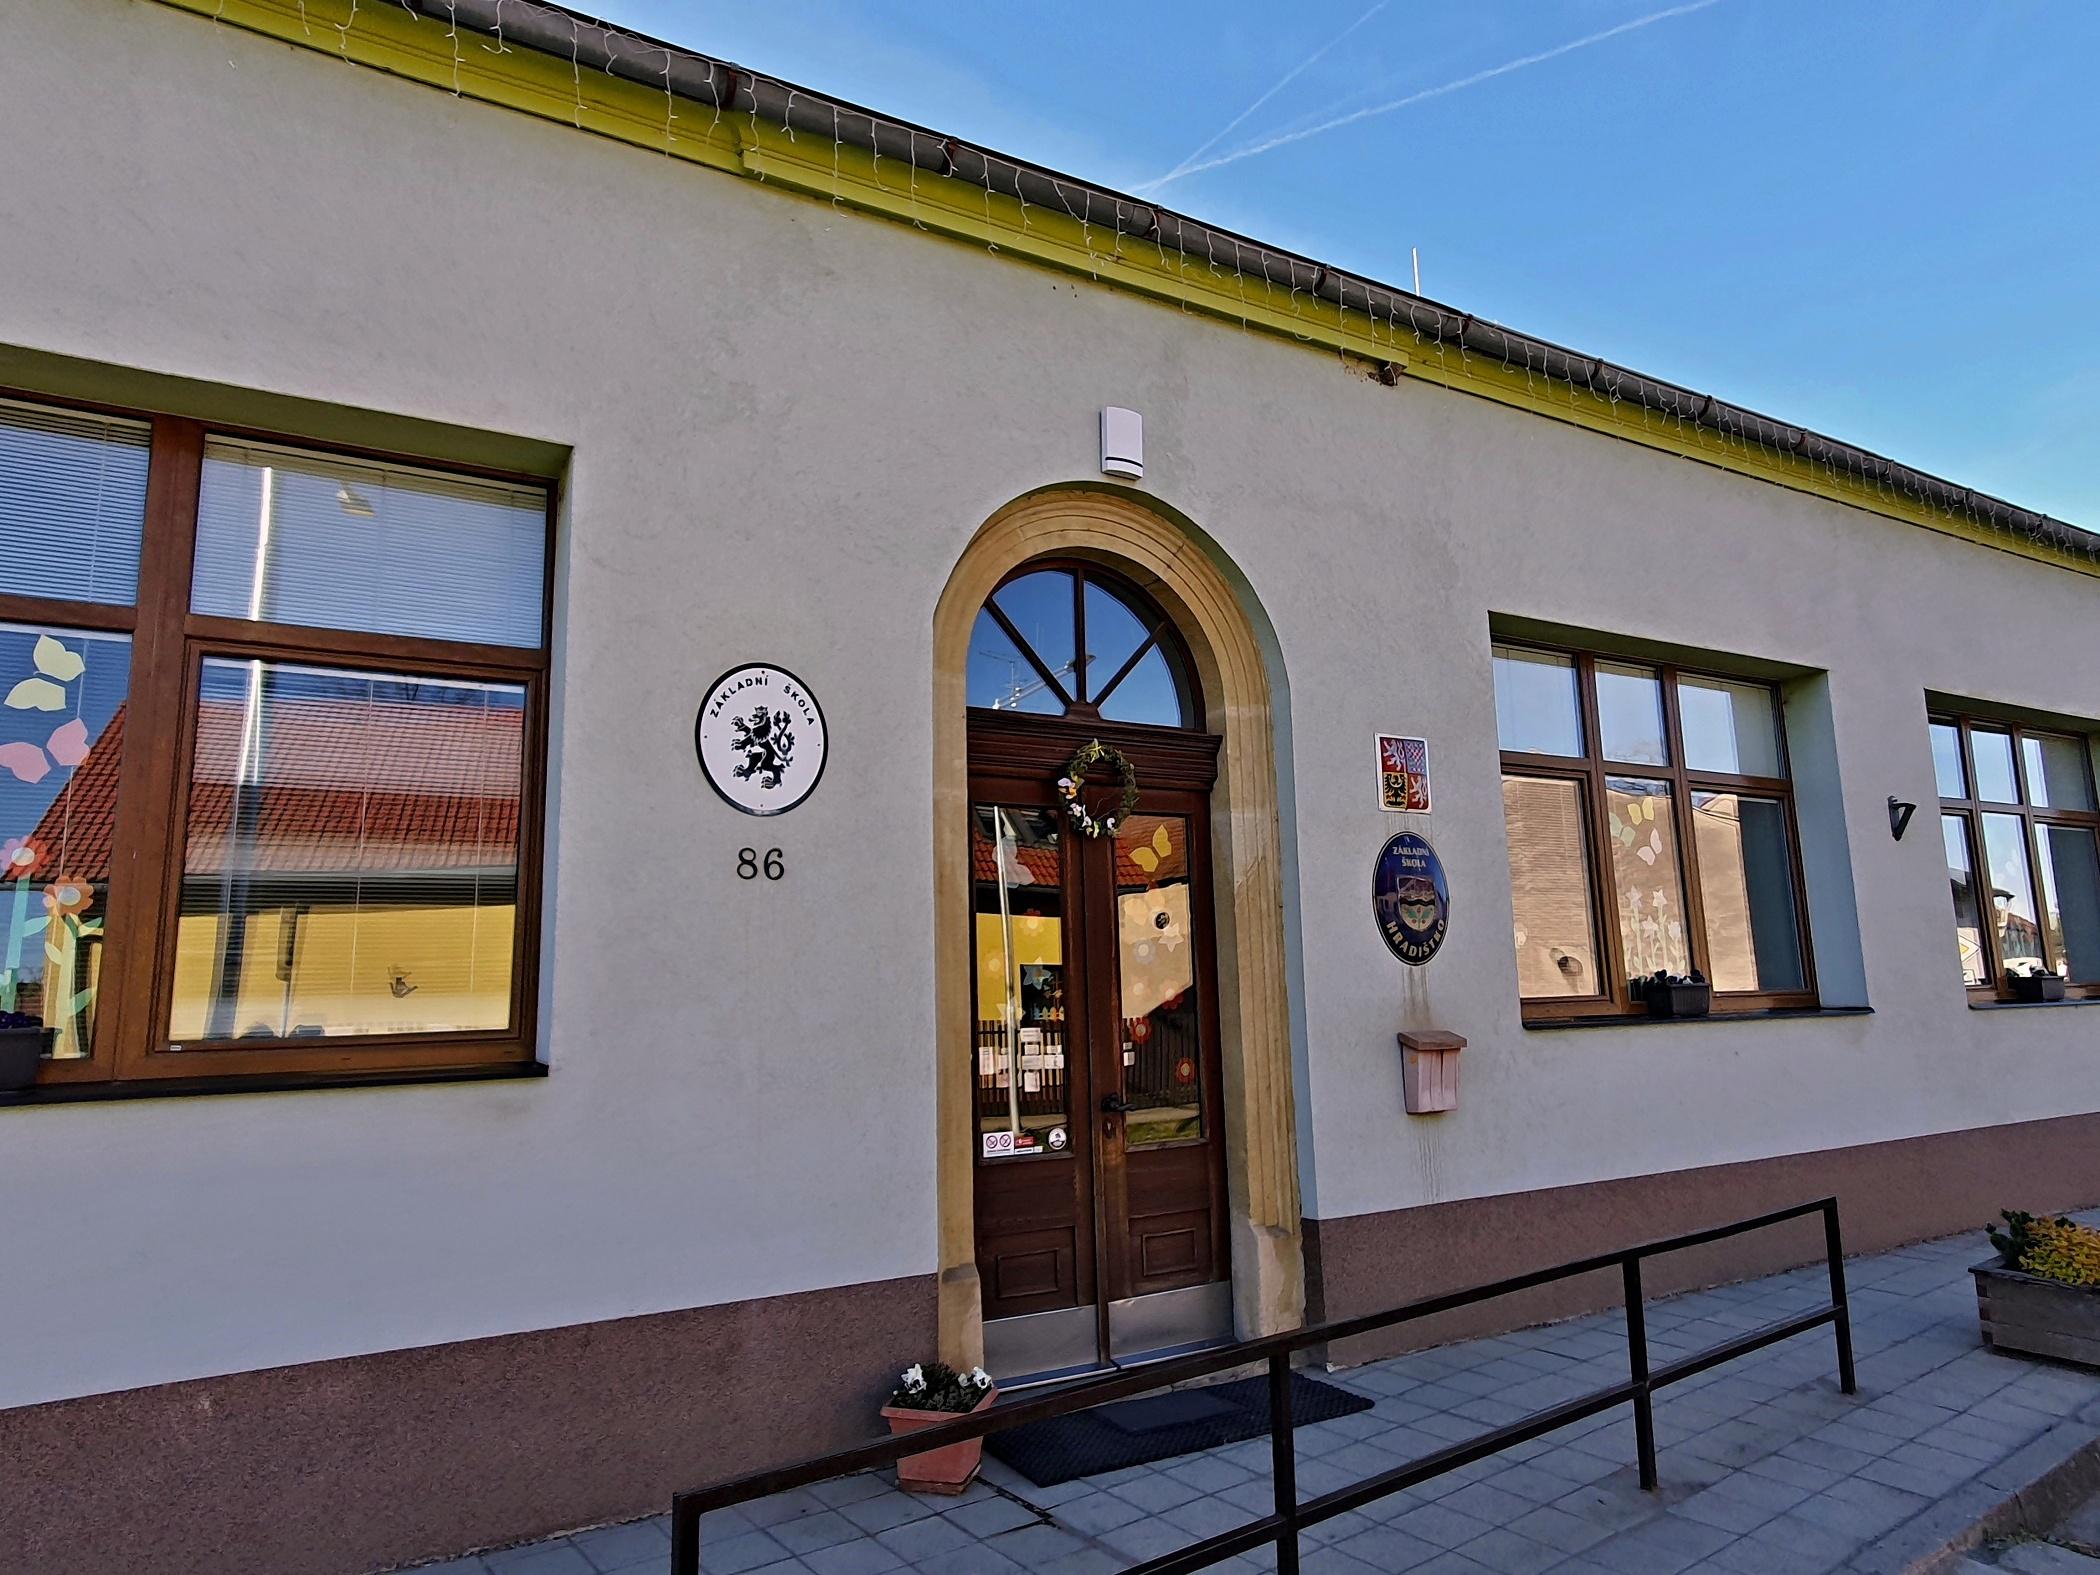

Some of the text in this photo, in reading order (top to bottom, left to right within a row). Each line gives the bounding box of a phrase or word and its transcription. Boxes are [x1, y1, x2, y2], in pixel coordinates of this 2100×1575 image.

[709, 674, 815, 726] ZÁKLADNÍ ŠKOLA
[1392, 845, 1430, 857] ZÁKLADNÍ
[1401, 856, 1427, 868] ŠKOLA
[736, 847, 785, 881] 86
